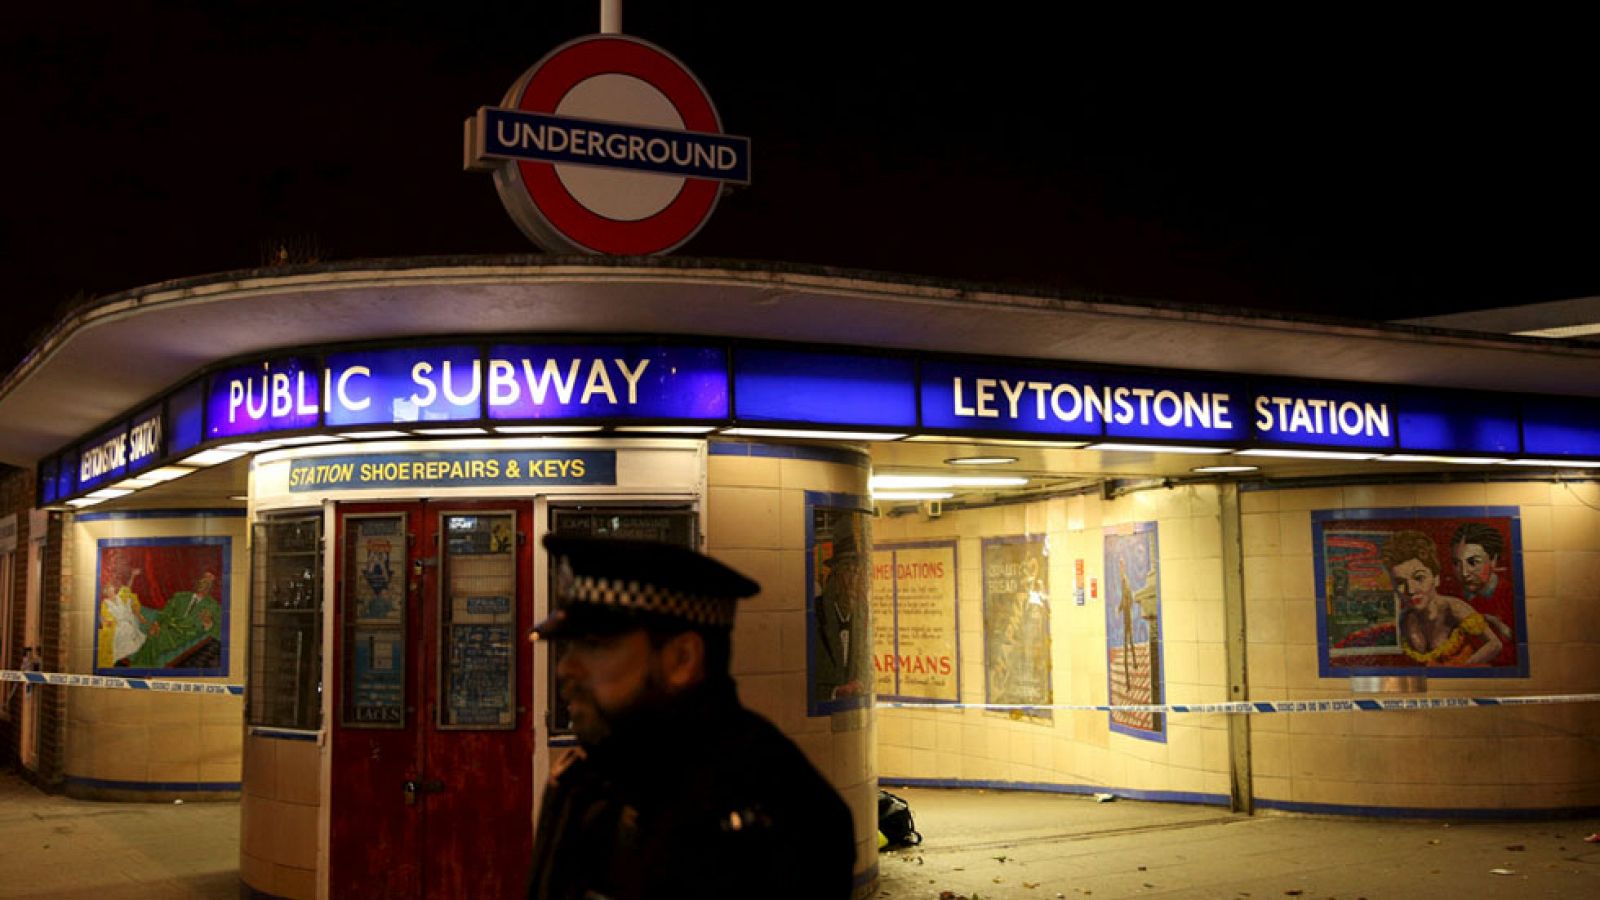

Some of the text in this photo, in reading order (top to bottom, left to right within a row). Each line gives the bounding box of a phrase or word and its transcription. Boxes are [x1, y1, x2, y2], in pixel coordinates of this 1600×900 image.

[497, 119, 738, 171] UNDERGROUND
[228, 358, 650, 423] PUBLIC SUBWAY
[953, 377, 1390, 438] LEYTONSTONE STATION
[290, 463, 355, 486] STATION
[506, 459, 521, 478] &
[529, 458, 586, 478] KEYS
